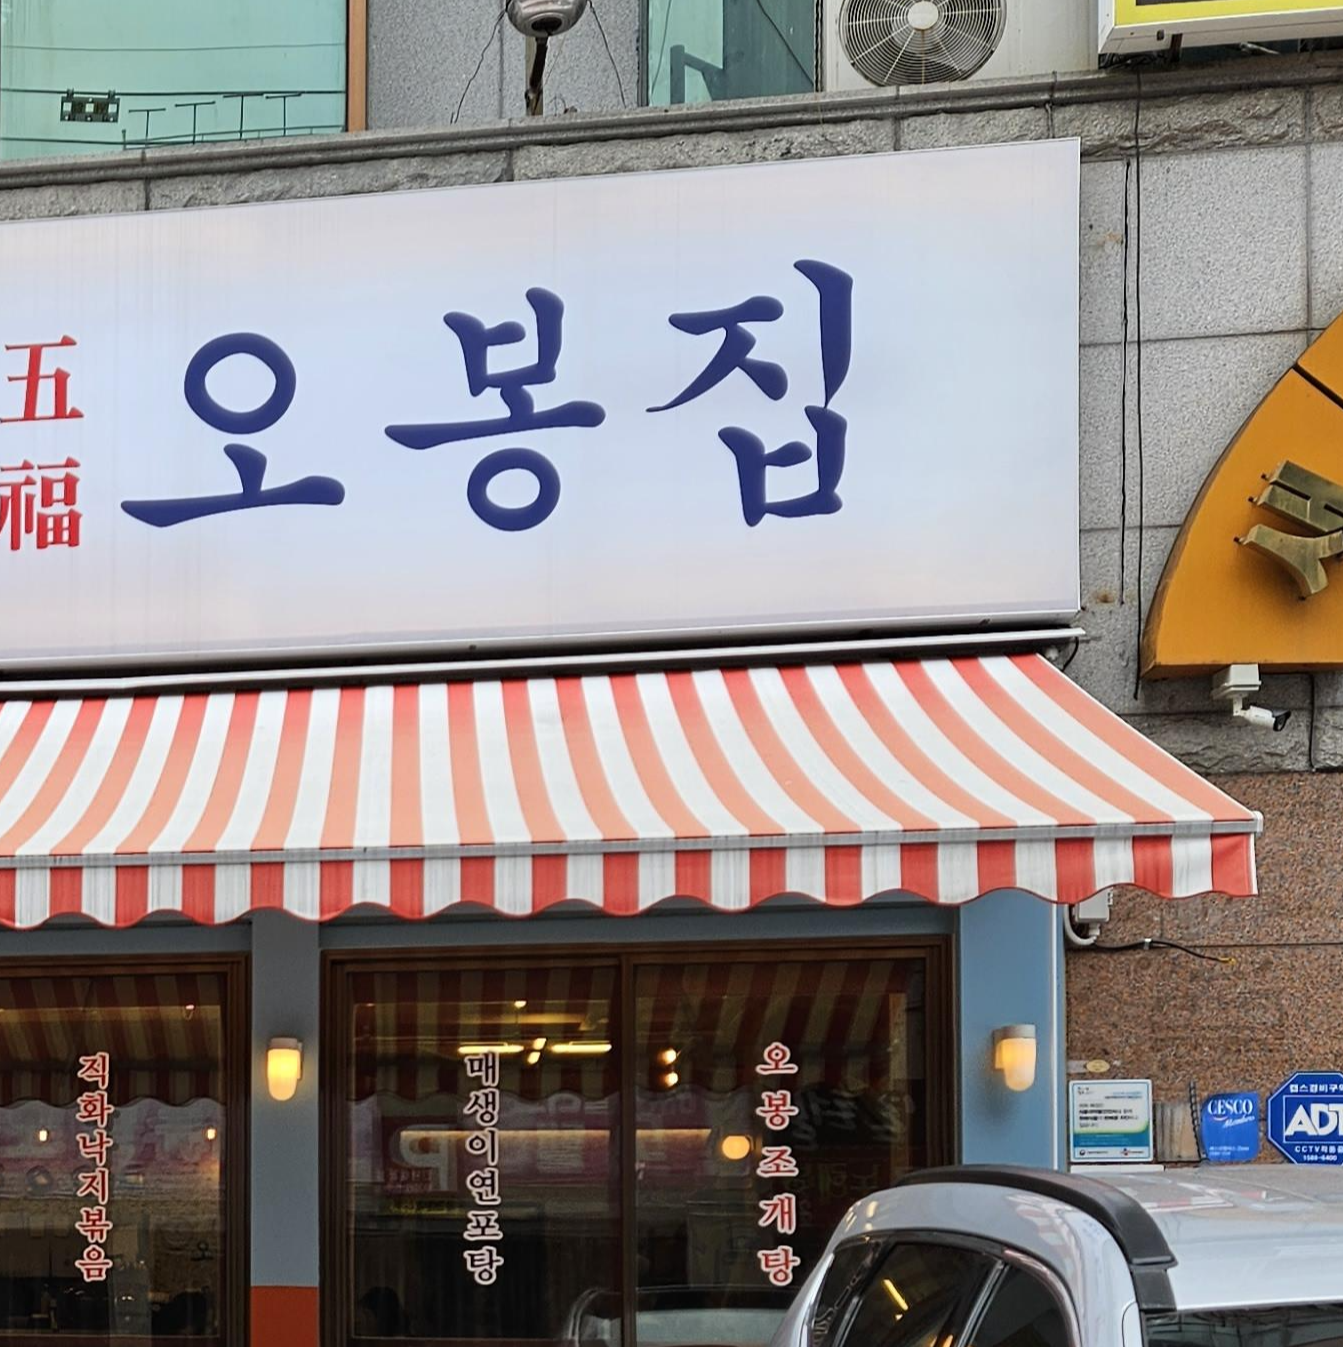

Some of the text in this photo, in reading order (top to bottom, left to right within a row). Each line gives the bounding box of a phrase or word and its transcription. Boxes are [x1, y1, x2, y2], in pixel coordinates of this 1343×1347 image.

[121, 259, 853, 531] 오봉집
[74, 1051, 113, 1283] 직화낙지볶음
[463, 1050, 503, 1286] 매생이연포탕
[755, 1041, 801, 1288] 오봉조개탕
[1207, 1099, 1253, 1115] CESCO
